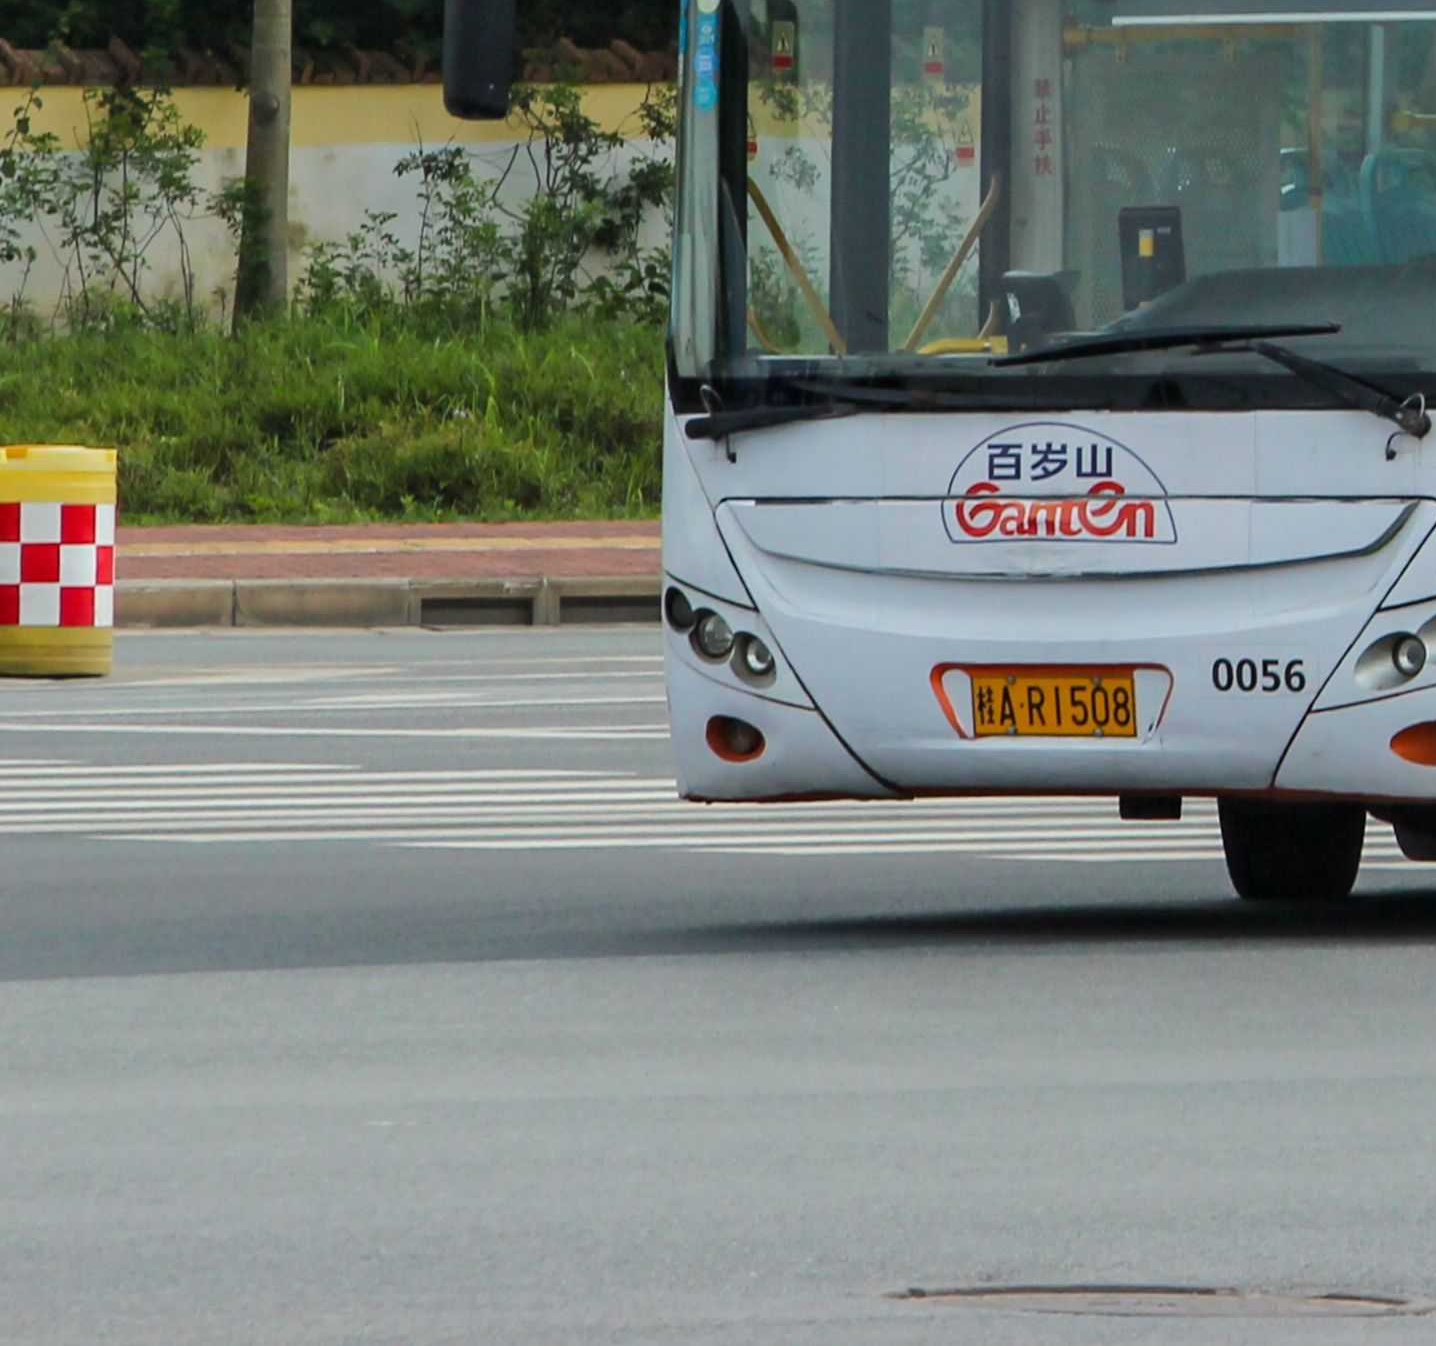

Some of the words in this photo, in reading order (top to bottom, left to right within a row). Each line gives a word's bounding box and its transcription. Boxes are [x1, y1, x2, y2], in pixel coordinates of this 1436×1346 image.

[987, 442, 1112, 481] 百岁山
[956, 481, 1154, 537] Ganten
[1212, 658, 1306, 692] 0056
